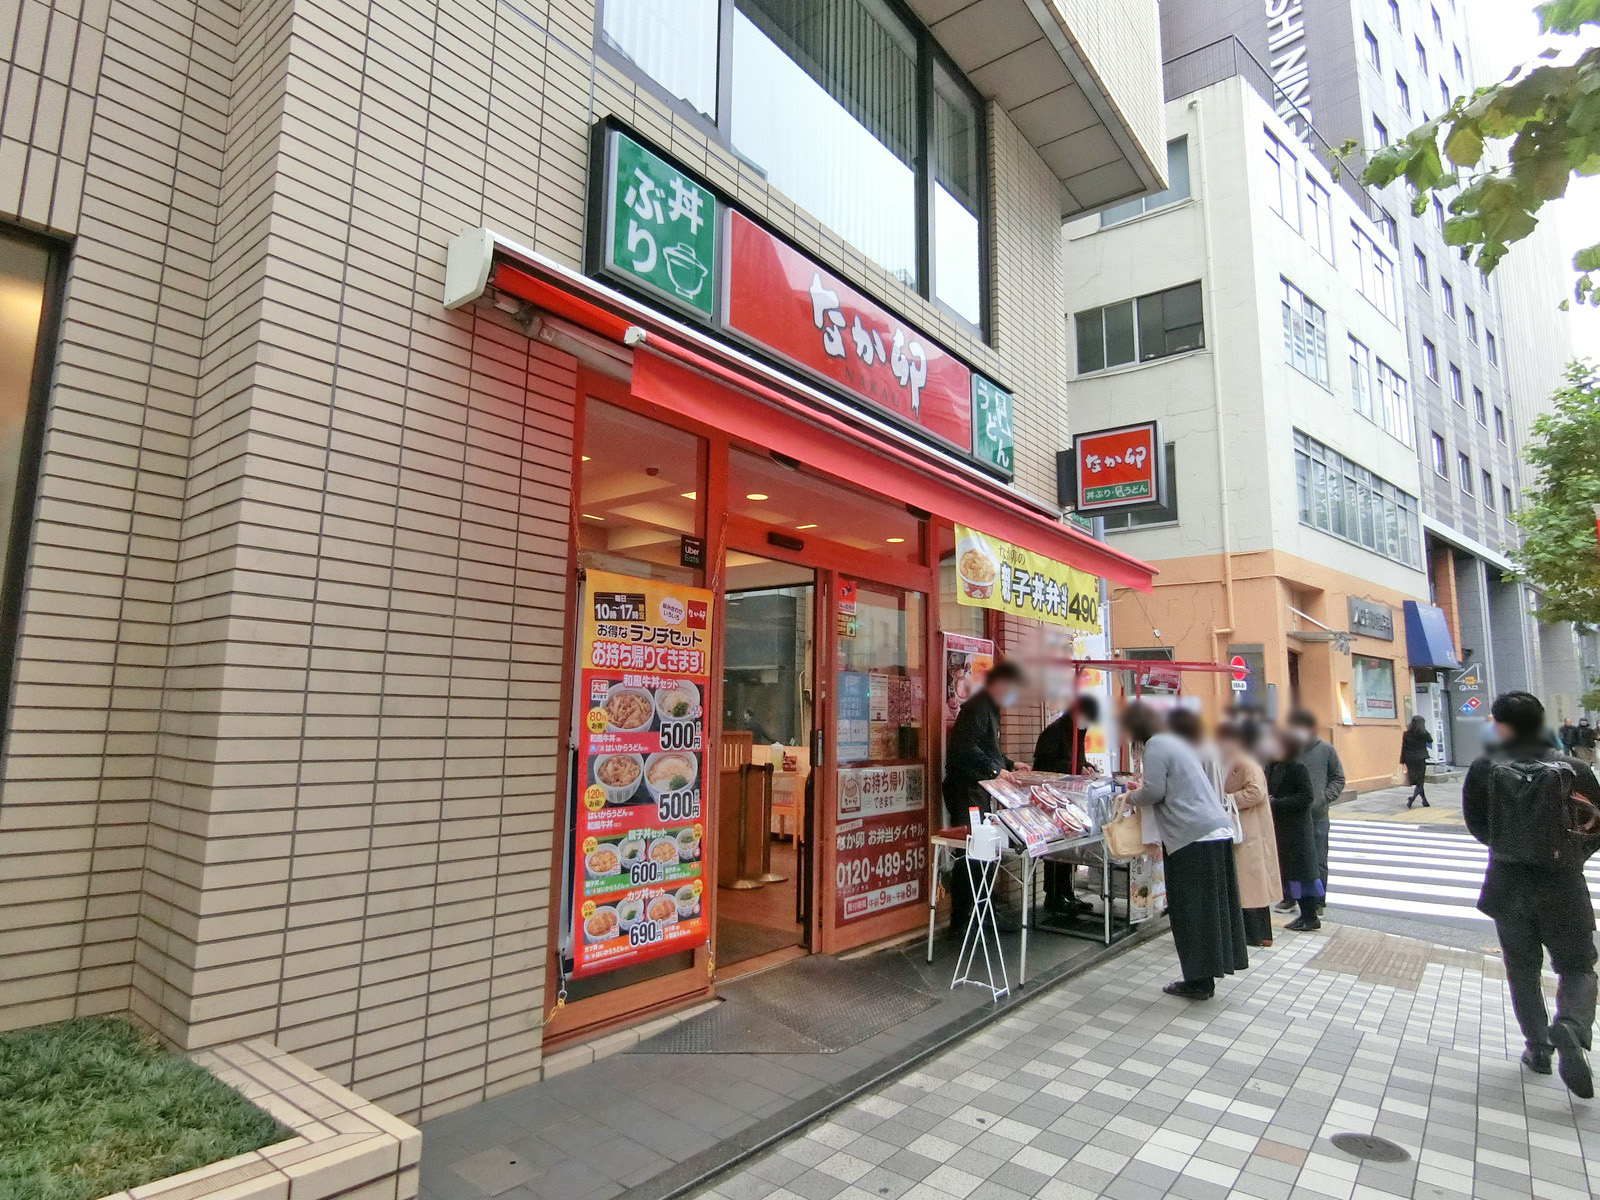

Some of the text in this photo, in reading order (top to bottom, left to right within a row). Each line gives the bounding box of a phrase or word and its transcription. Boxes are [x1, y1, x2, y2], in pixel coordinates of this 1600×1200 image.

[810, 271, 927, 419] なか卯
[844, 366, 900, 408] NAKAU
[1085, 446, 1147, 474] なか卯
[684, 546, 699, 556] Uber
[684, 554, 699, 563] Eats
[614, 594, 627, 602] 毎日
[688, 608, 707, 622] なか卯
[593, 682, 608, 693] 大盛
[623, 674, 679, 691] 和風牛丼セット
[862, 771, 905, 795] お持ち帰り
[873, 797, 894, 809] できます
[627, 887, 666, 902] カツ丼セット
